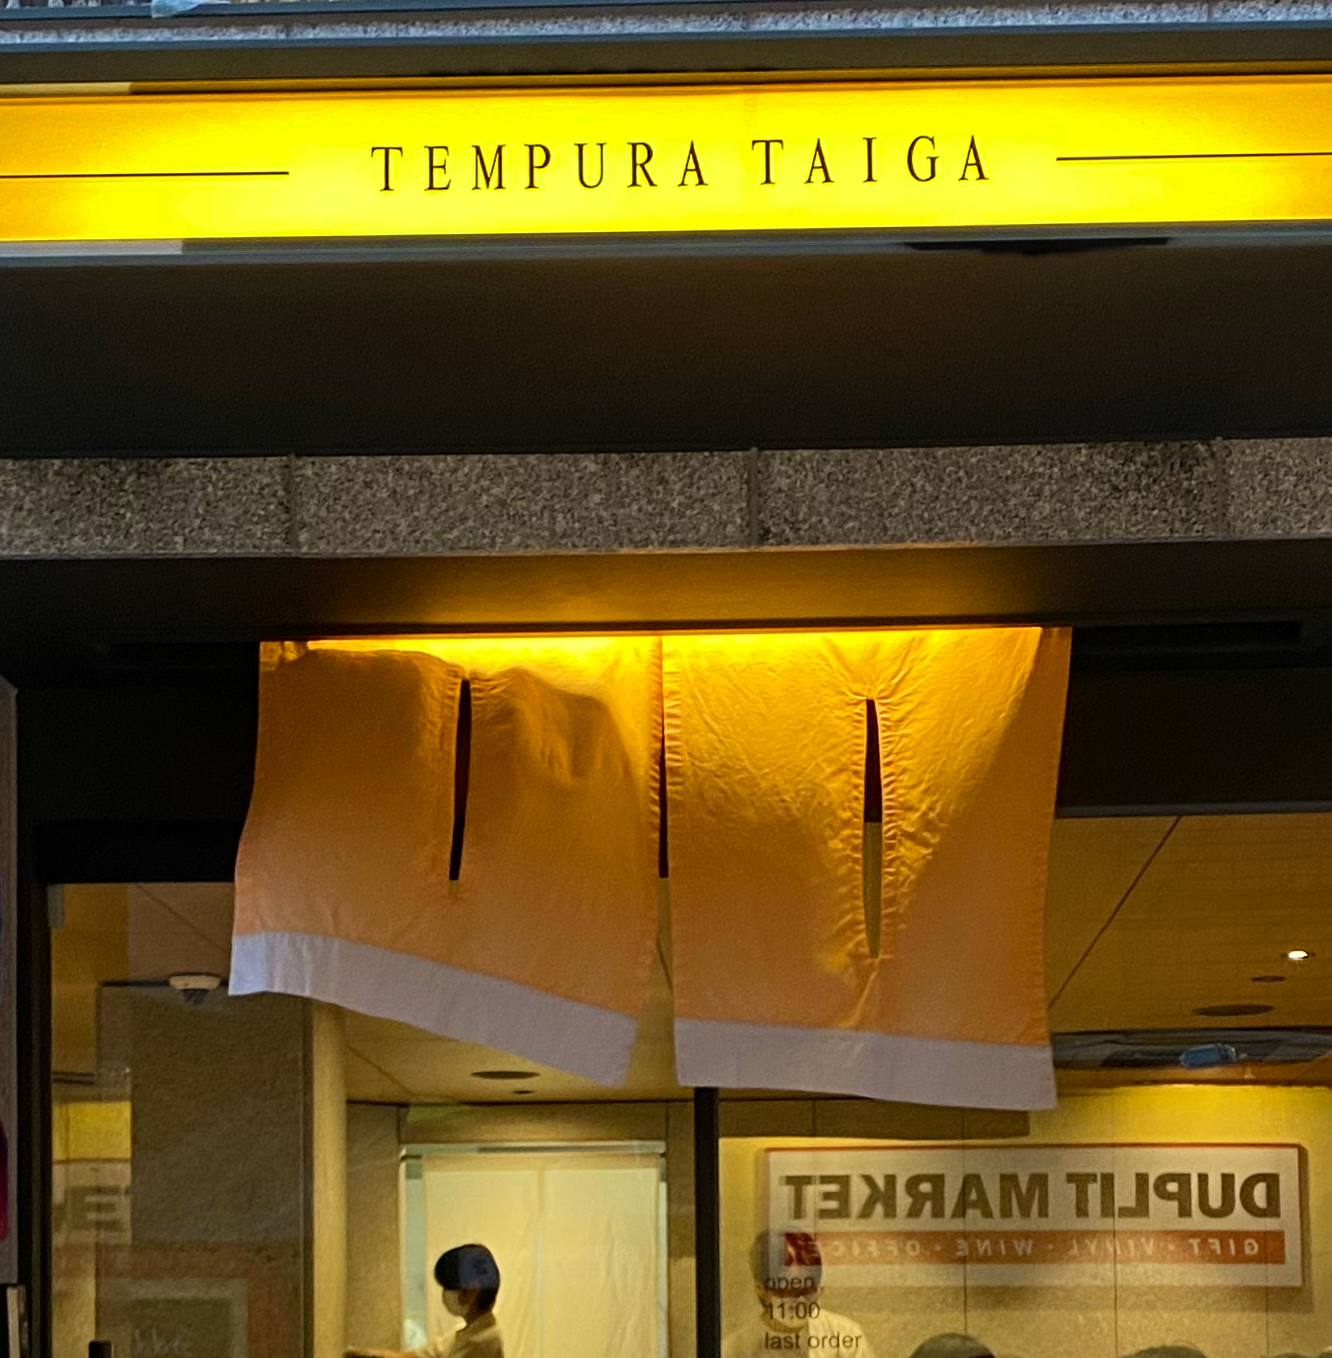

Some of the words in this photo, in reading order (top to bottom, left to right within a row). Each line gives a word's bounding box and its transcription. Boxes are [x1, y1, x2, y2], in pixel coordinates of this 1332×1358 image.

[370, 140, 709, 192] TEMPURA
[750, 134, 990, 186] TAIGA
[763, 1276, 816, 1295] open
[768, 1302, 820, 1320] 11:00
[764, 1331, 801, 1350] last
[807, 1331, 863, 1349] order
